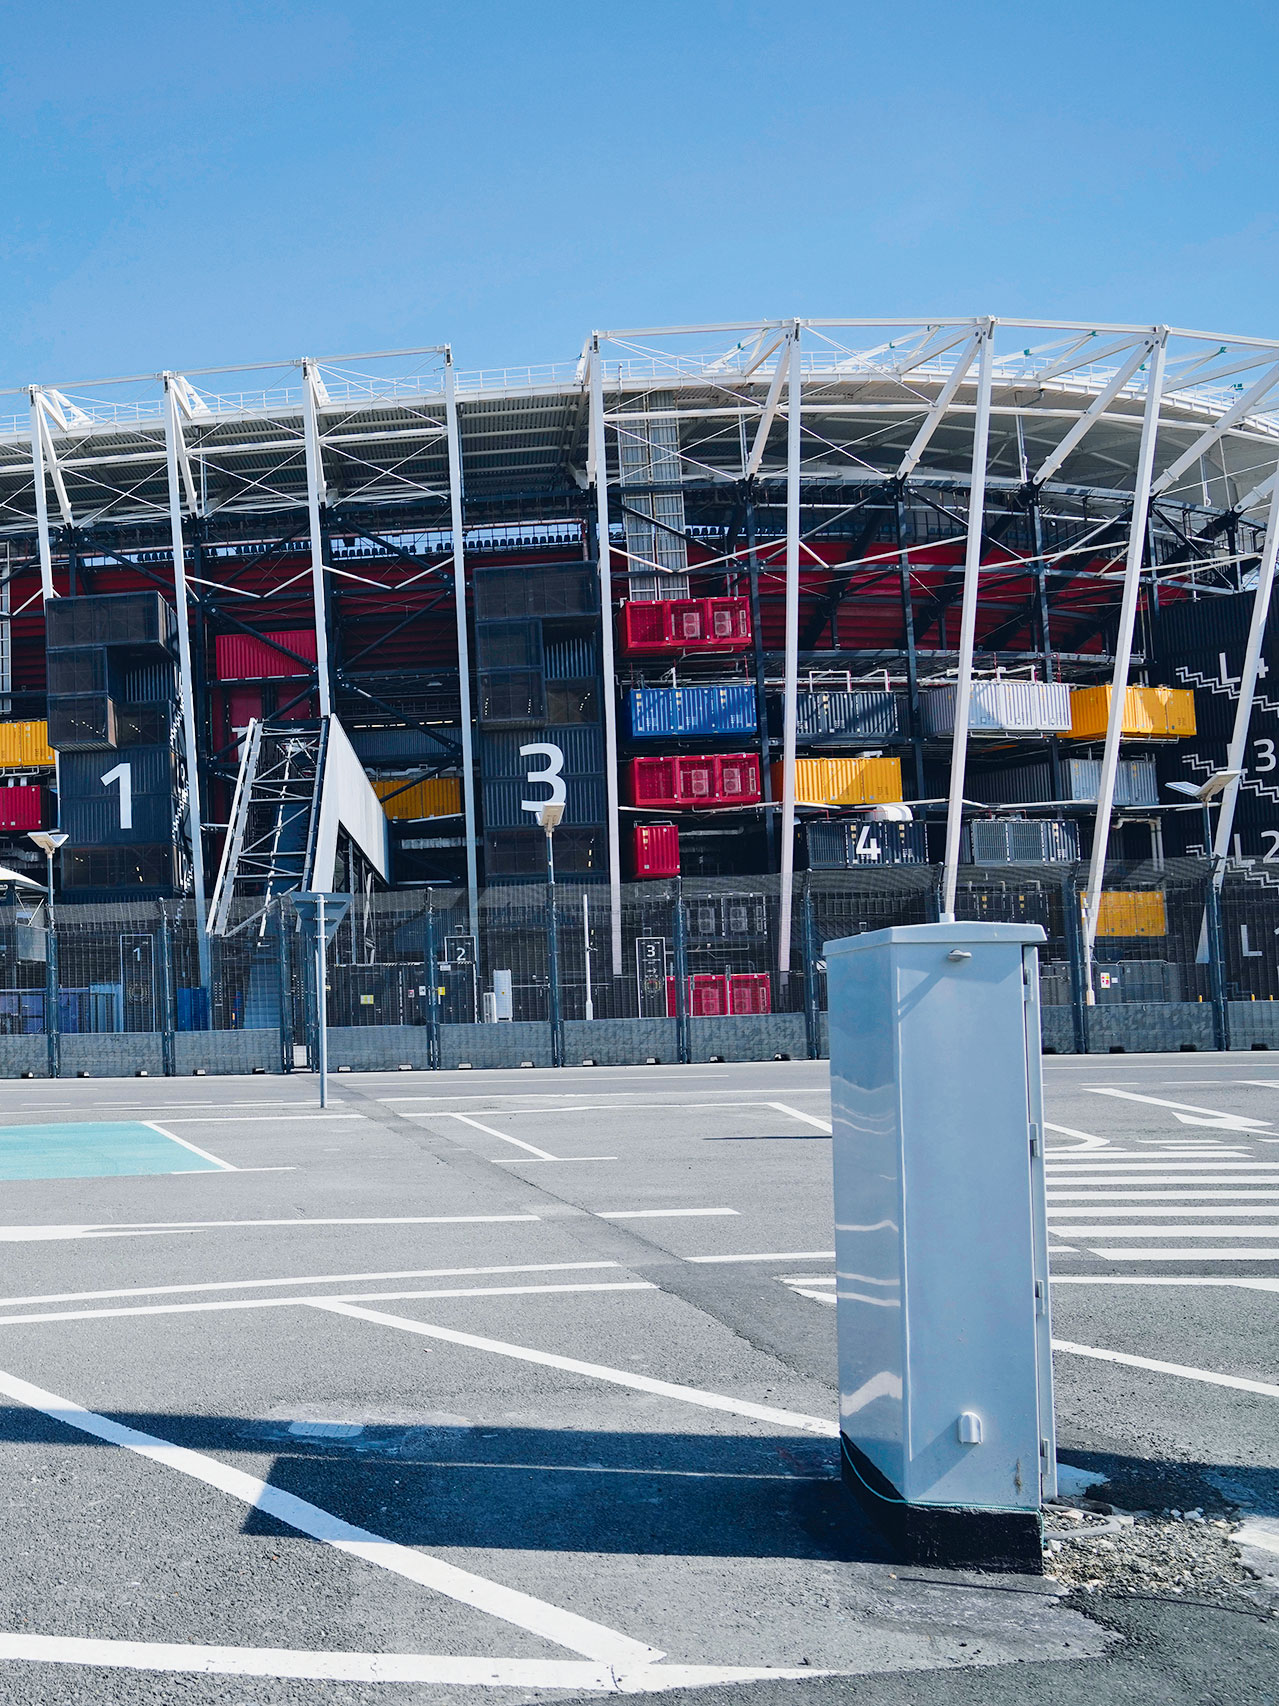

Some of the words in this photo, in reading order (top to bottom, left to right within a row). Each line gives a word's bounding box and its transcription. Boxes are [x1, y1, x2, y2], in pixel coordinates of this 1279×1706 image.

[519, 742, 566, 812] 3
[100, 762, 132, 829] 1
[856, 825, 881, 860] 4
[133, 947, 141, 961] 1
[456, 946, 466, 961] 2
[646, 944, 656, 958] 3
